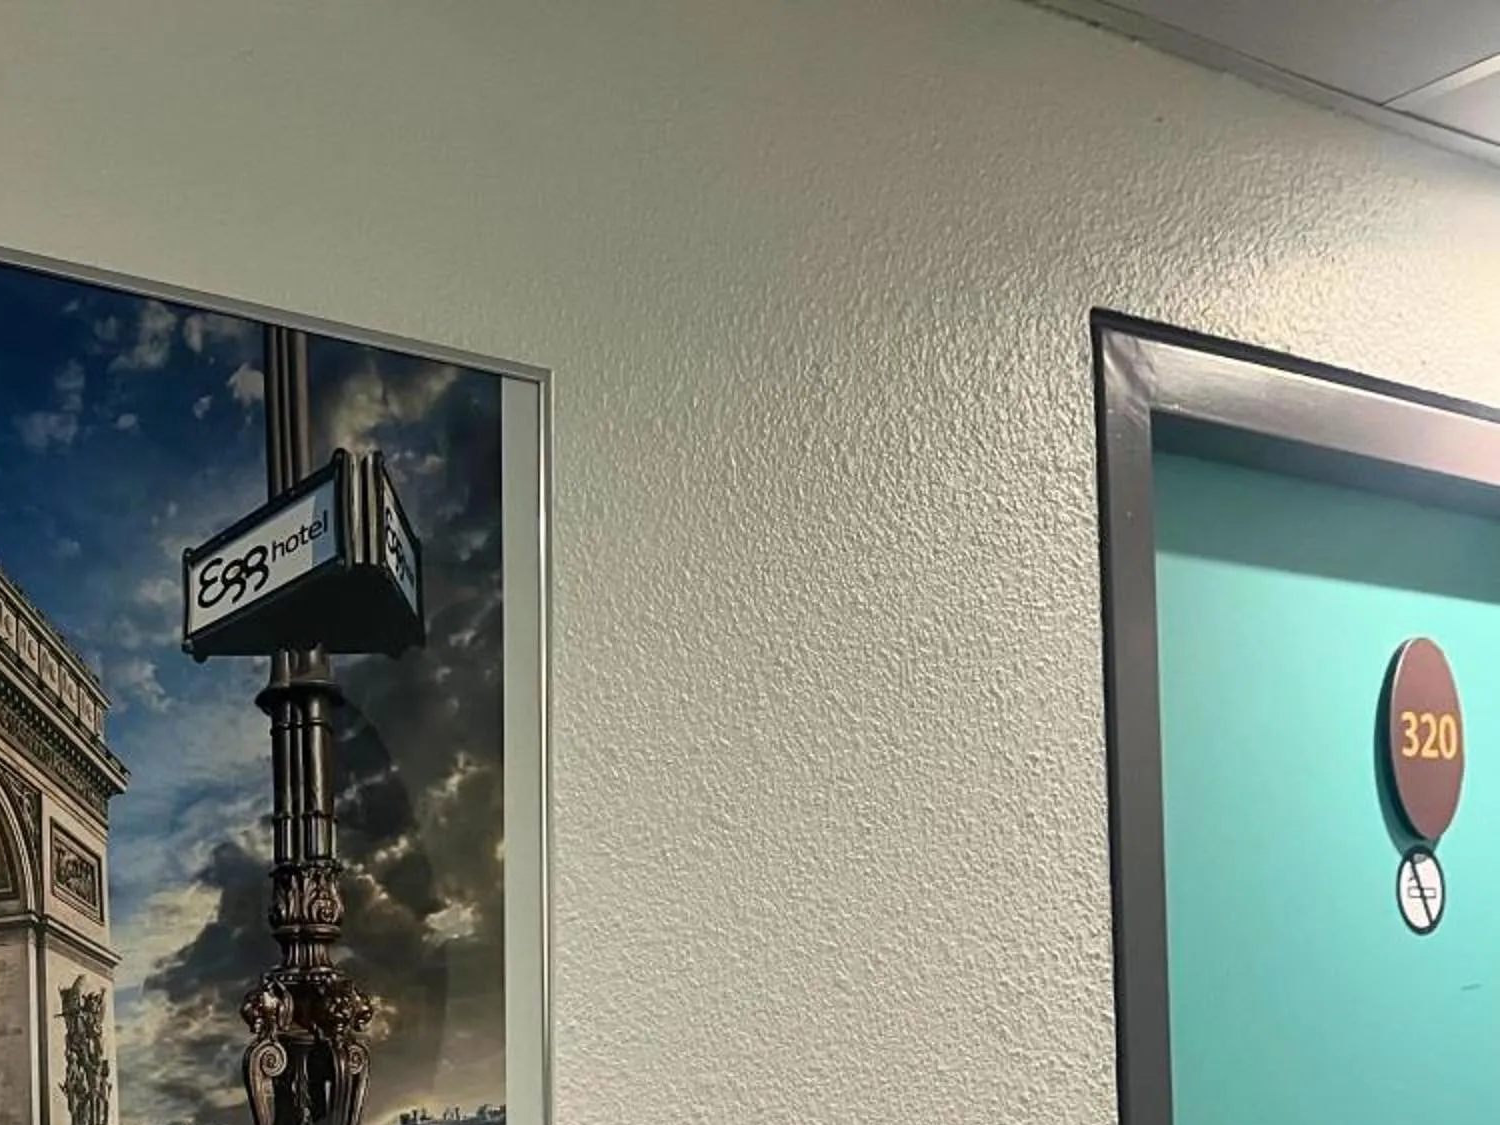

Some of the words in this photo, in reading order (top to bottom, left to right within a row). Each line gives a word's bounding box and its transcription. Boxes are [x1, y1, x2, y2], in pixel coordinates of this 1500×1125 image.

[197, 546, 270, 609] Egg
[271, 509, 328, 563] hotel
[1401, 711, 1458, 760] 320
